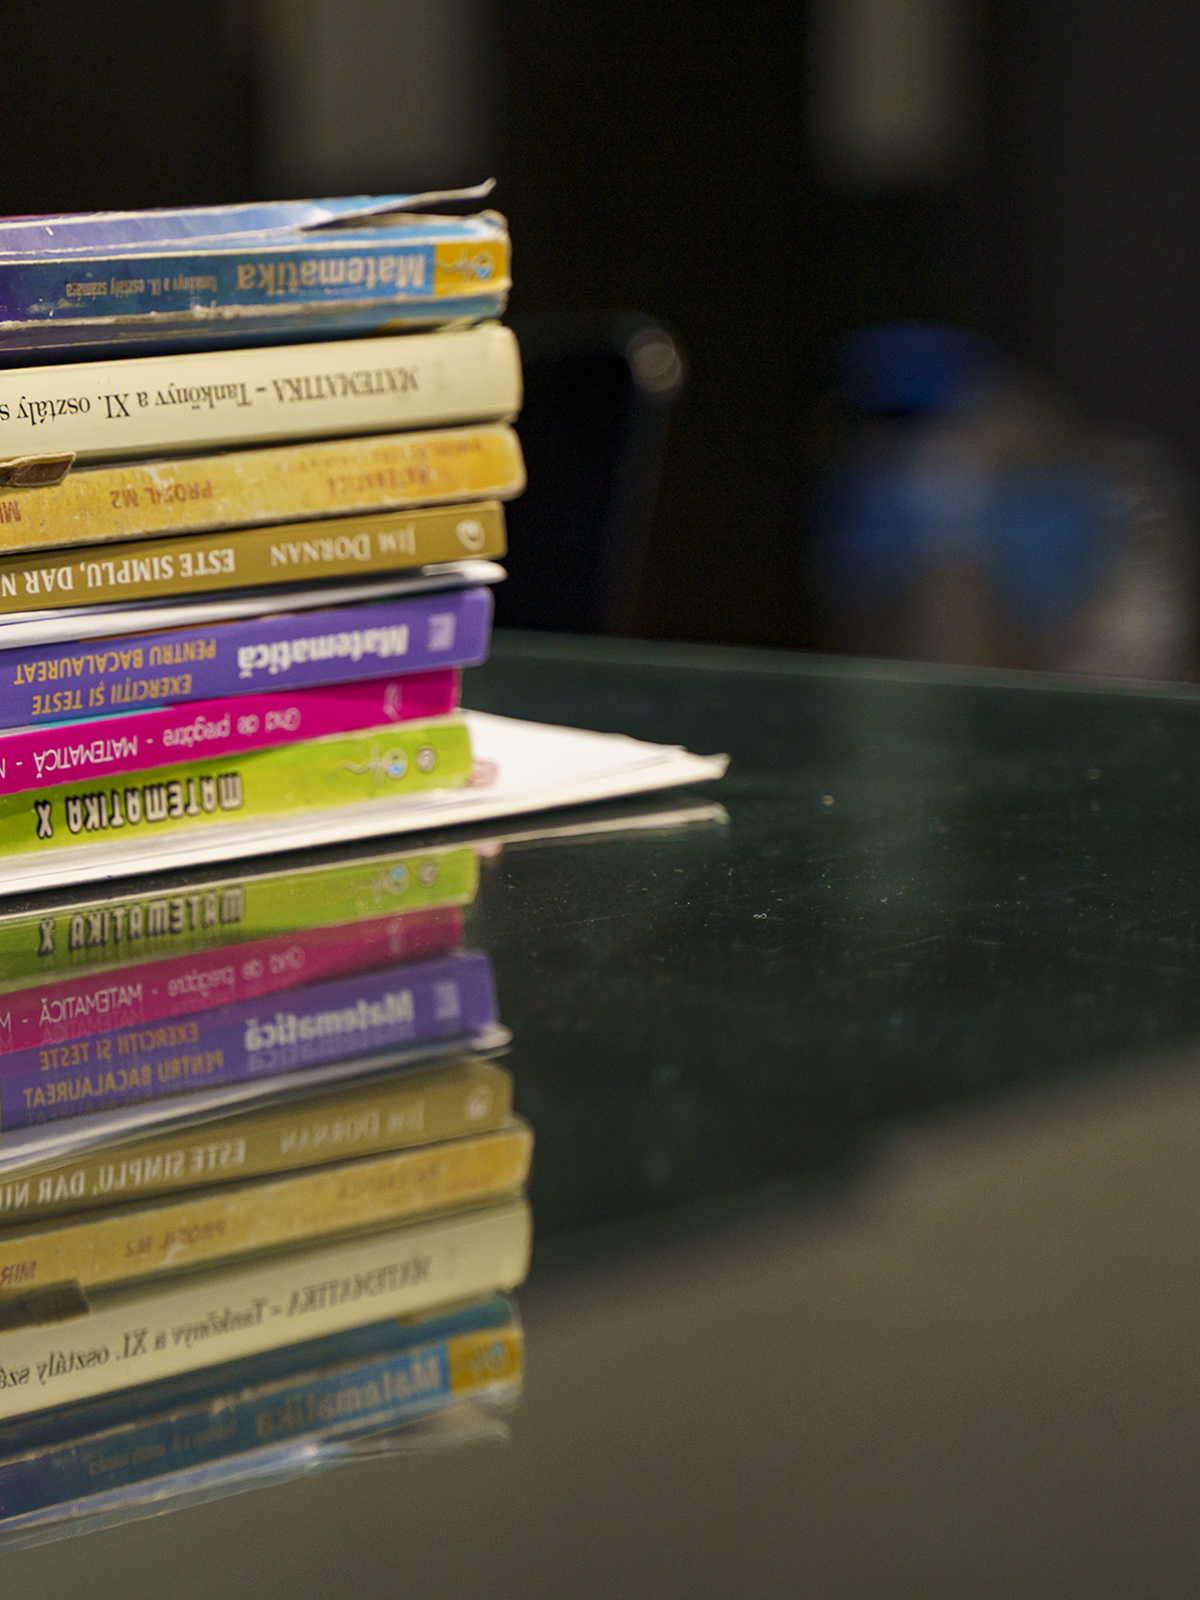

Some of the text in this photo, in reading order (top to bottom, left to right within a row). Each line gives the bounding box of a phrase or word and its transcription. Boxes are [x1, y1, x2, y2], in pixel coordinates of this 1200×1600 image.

[237, 254, 426, 295] Matematika
[135, 391, 148, 408] a
[153, 381, 252, 411] Tankönyv
[271, 366, 419, 404] MATEMATIKA
[17, 396, 91, 427] osztály
[97, 392, 131, 419] XI.
[109, 487, 138, 510] M2
[179, 548, 236, 578] ESTE
[270, 533, 371, 567] DORNAN
[23, 567, 74, 595] DAR
[79, 554, 174, 588] SIMPLU,
[13, 638, 217, 685] PENTRU BACALAUREAT
[237, 624, 409, 679] Matematică
[31, 690, 83, 715] TESTE
[33, 735, 138, 779] MATEMATICĂ
[34, 772, 242, 840] MATEMATIKA X
